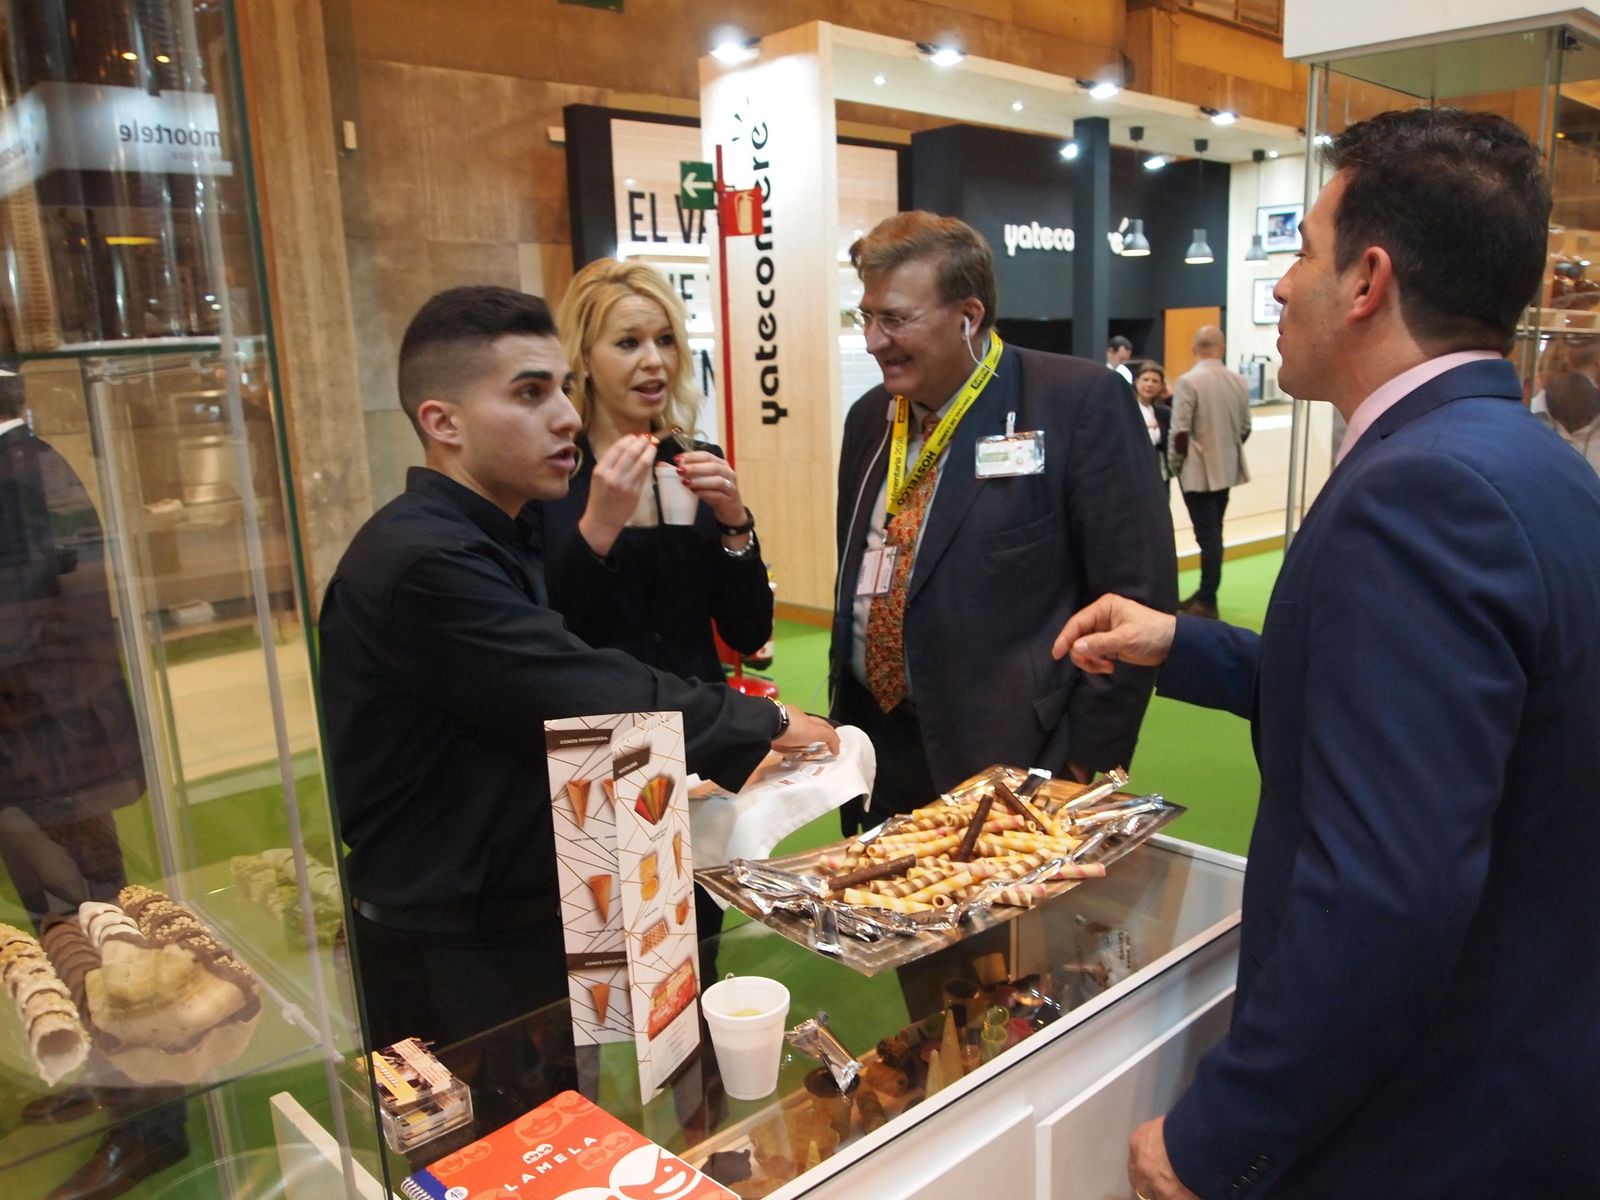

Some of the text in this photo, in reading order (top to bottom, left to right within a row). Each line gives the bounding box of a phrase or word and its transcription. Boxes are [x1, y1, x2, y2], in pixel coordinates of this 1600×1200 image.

[628, 191, 668, 242] EL
[897, 450, 937, 506] HOSTELCO
[503, 1136, 599, 1193] LAMELA
